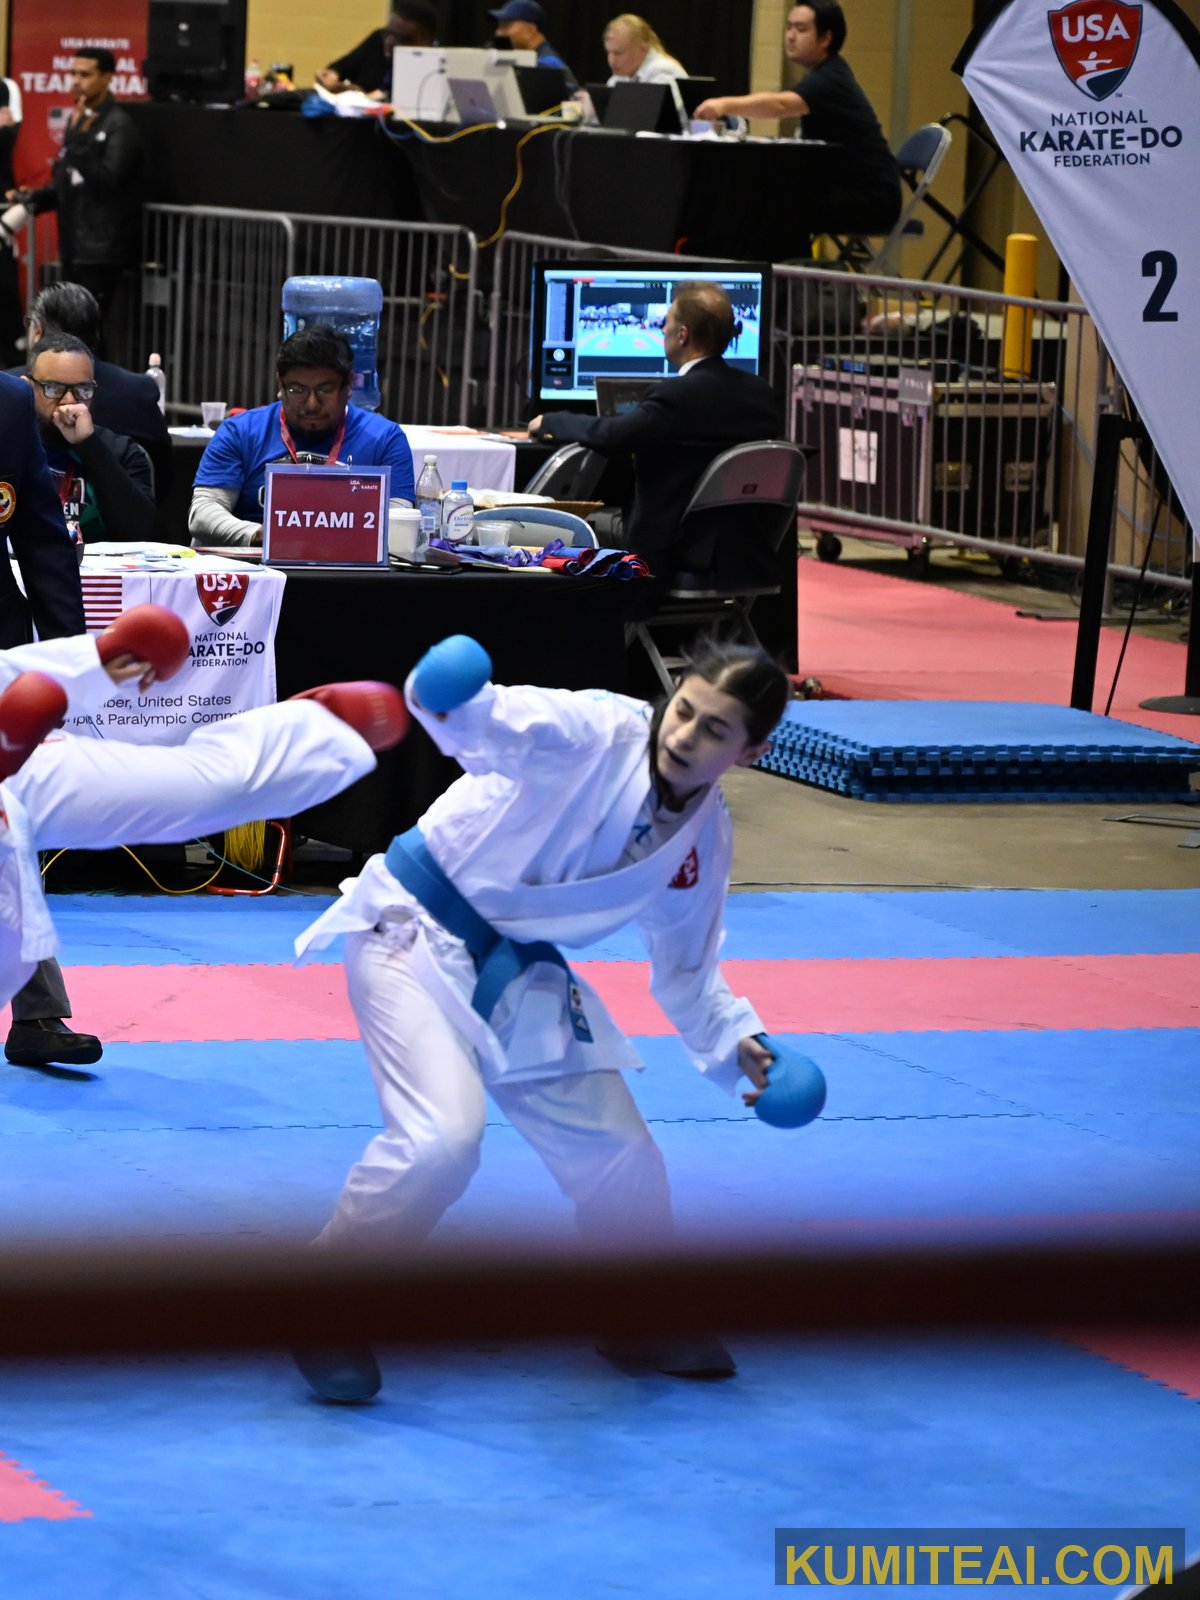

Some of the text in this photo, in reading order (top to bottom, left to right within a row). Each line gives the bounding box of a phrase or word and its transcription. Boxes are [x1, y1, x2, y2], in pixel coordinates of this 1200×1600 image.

[1061, 13, 1131, 43] USA
[1051, 109, 1148, 127] NATIONAL
[1020, 126, 1183, 152] KARATE-DO
[1054, 152, 1150, 168] FEDERATION
[1141, 249, 1178, 322] 2
[63, 502, 79, 515] EN
[275, 510, 375, 529] TATAMI 2
[202, 574, 242, 592] USA
[195, 631, 249, 643] NATIONAL
[188, 641, 265, 658] ARATE-DO
[192, 657, 248, 668] FEDERATION
[103, 694, 232, 710] ber, United States
[96, 712, 104, 725] &
[108, 711, 187, 727] Paralympic
